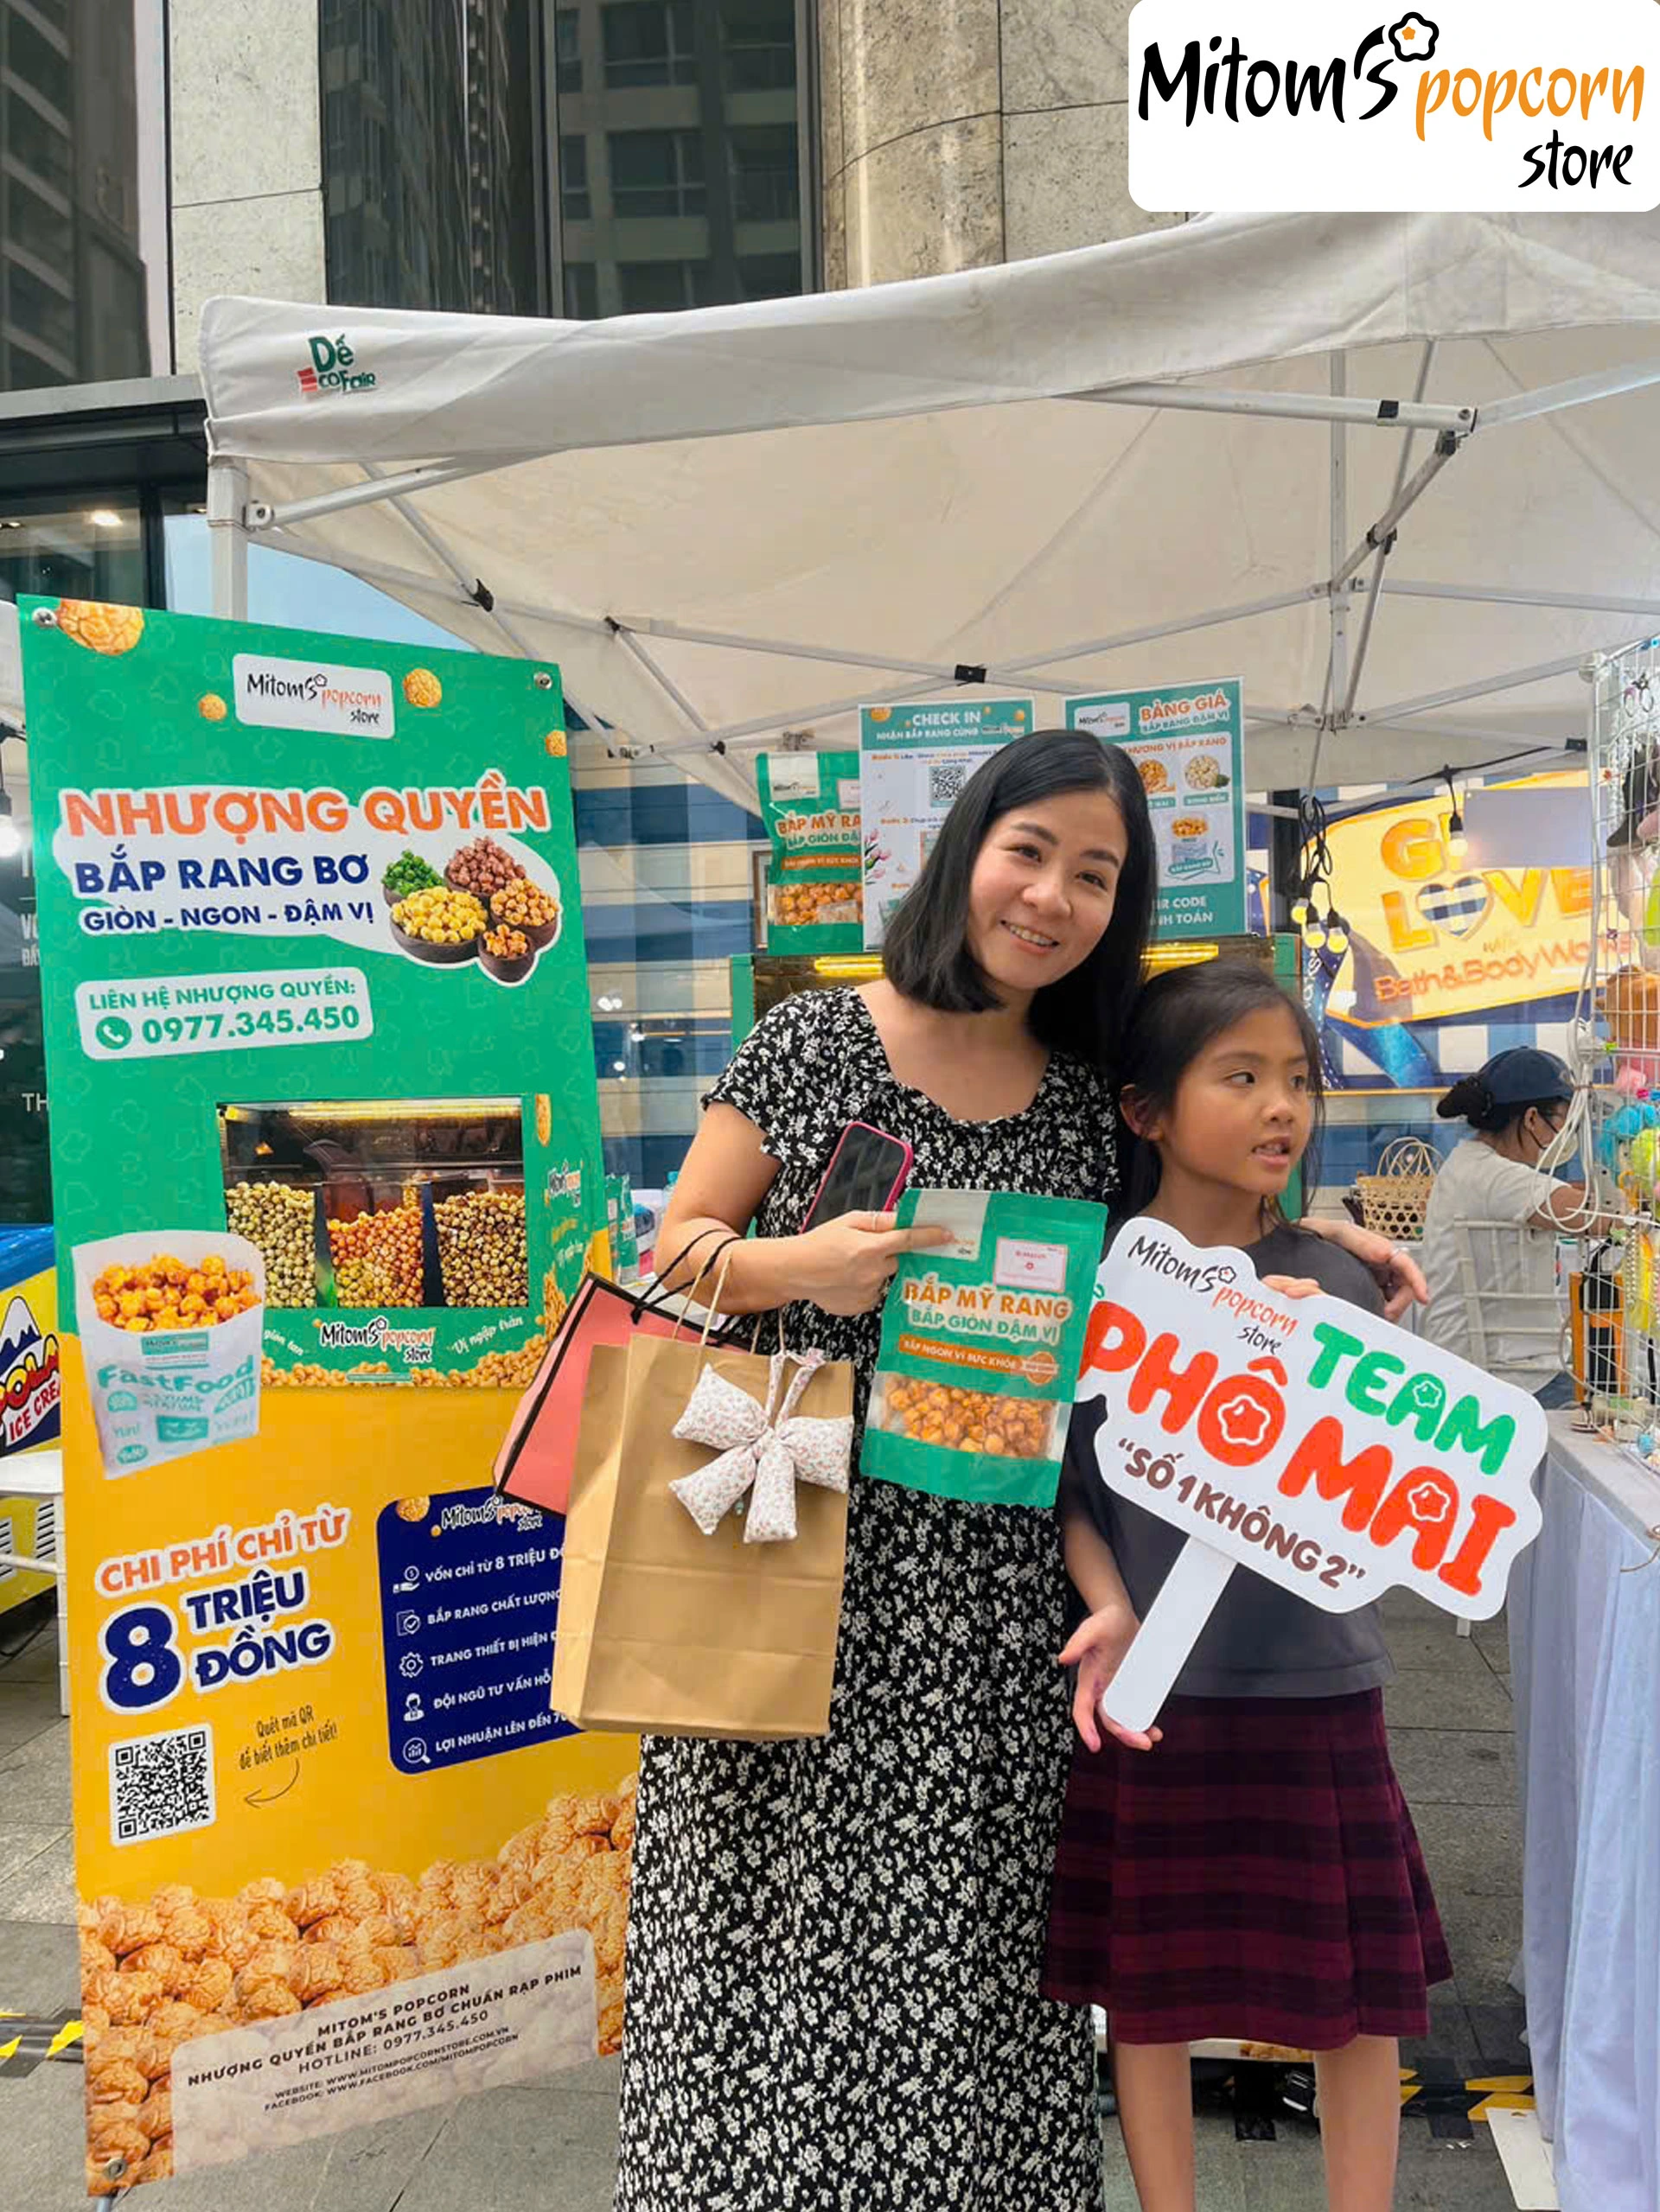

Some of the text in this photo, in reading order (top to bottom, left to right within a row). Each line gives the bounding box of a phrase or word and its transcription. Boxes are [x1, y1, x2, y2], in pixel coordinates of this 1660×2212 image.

[321, 688, 382, 711] popcorn
[350, 708, 380, 724] store
[912, 711, 982, 726] CHECK IN
[1140, 687, 1229, 722] BẢNG GIÁ
[65, 772, 547, 846] NHƯỢNG QUYỀN
[778, 812, 806, 835] BẮP
[811, 812, 836, 830] MỸ
[841, 814, 862, 828] RA
[75, 844, 370, 893] BẮP RANG BƠ
[84, 906, 156, 932] GIÒN
[182, 905, 259, 927] NGON
[284, 898, 343, 927] ĐẬM
[348, 902, 374, 925] VỊ
[1172, 896, 1207, 908] CODE
[1177, 909, 1213, 924] TOÁN
[90, 973, 356, 1010] LIÊN HỆ NHƯỢNG QUYỀN:
[141, 1005, 361, 1044] 0977.345.450
[904, 1275, 1069, 1320] BẮP MỸ RANG
[1211, 1284, 1299, 1336] popcorn
[381, 1329, 435, 1352] popcorn
[911, 1304, 1058, 1344] BẮP GIÒN ĐẬM VỊ
[1237, 1324, 1281, 1355] store
[405, 1347, 431, 1363] store
[9, 1380, 61, 1442] ICE CRE
[1306, 1322, 1516, 1476] TEAM
[1077, 1300, 1517, 1597] PHÔ MAI
[1177, 1479, 1197, 1502] 1
[1193, 1482, 1323, 1578] KHÔNG
[101, 1508, 346, 1591] CHI PHÍ CHỈ TỪ
[425, 1565, 452, 1583] VỐN
[455, 1560, 475, 1578] CHỈ
[477, 1559, 495, 1573] TỪ
[495, 1556, 505, 1571] 8
[508, 1547, 546, 1567] TRIỆU
[427, 1606, 452, 1625] BẮP
[454, 1603, 489, 1620] RANG
[491, 1593, 521, 1612] CHẤT
[105, 1569, 303, 1707] 8 TRIỆU
[195, 1625, 330, 1687] ĐỒNG
[431, 1648, 472, 1667] TRANG
[475, 1637, 506, 1658] THIẾT
[508, 1639, 520, 1653] BỊ
[521, 1631, 548, 1648] HIỆN
[433, 1692, 456, 1710] ĐỘI
[458, 1686, 486, 1704] NGŨ
[488, 1683, 504, 1697] TƯ
[506, 1674, 533, 1692] VẤN
[299, 1704, 315, 1724] QR
[436, 1737, 456, 1753] LỢI
[457, 1726, 503, 1747] NHUẬN
[505, 1720, 527, 1736] LÊN
[528, 1712, 552, 1730] ĐẾN
[188, 1965, 582, 2087] NHƯỢNG QUYỀN BẮP RANG BƠ CHUẨN RẠP PHIM
[318, 1984, 470, 2037] MITOM'S POPCORN
[299, 2009, 488, 2074] HOTLINE: 0977.345.450
